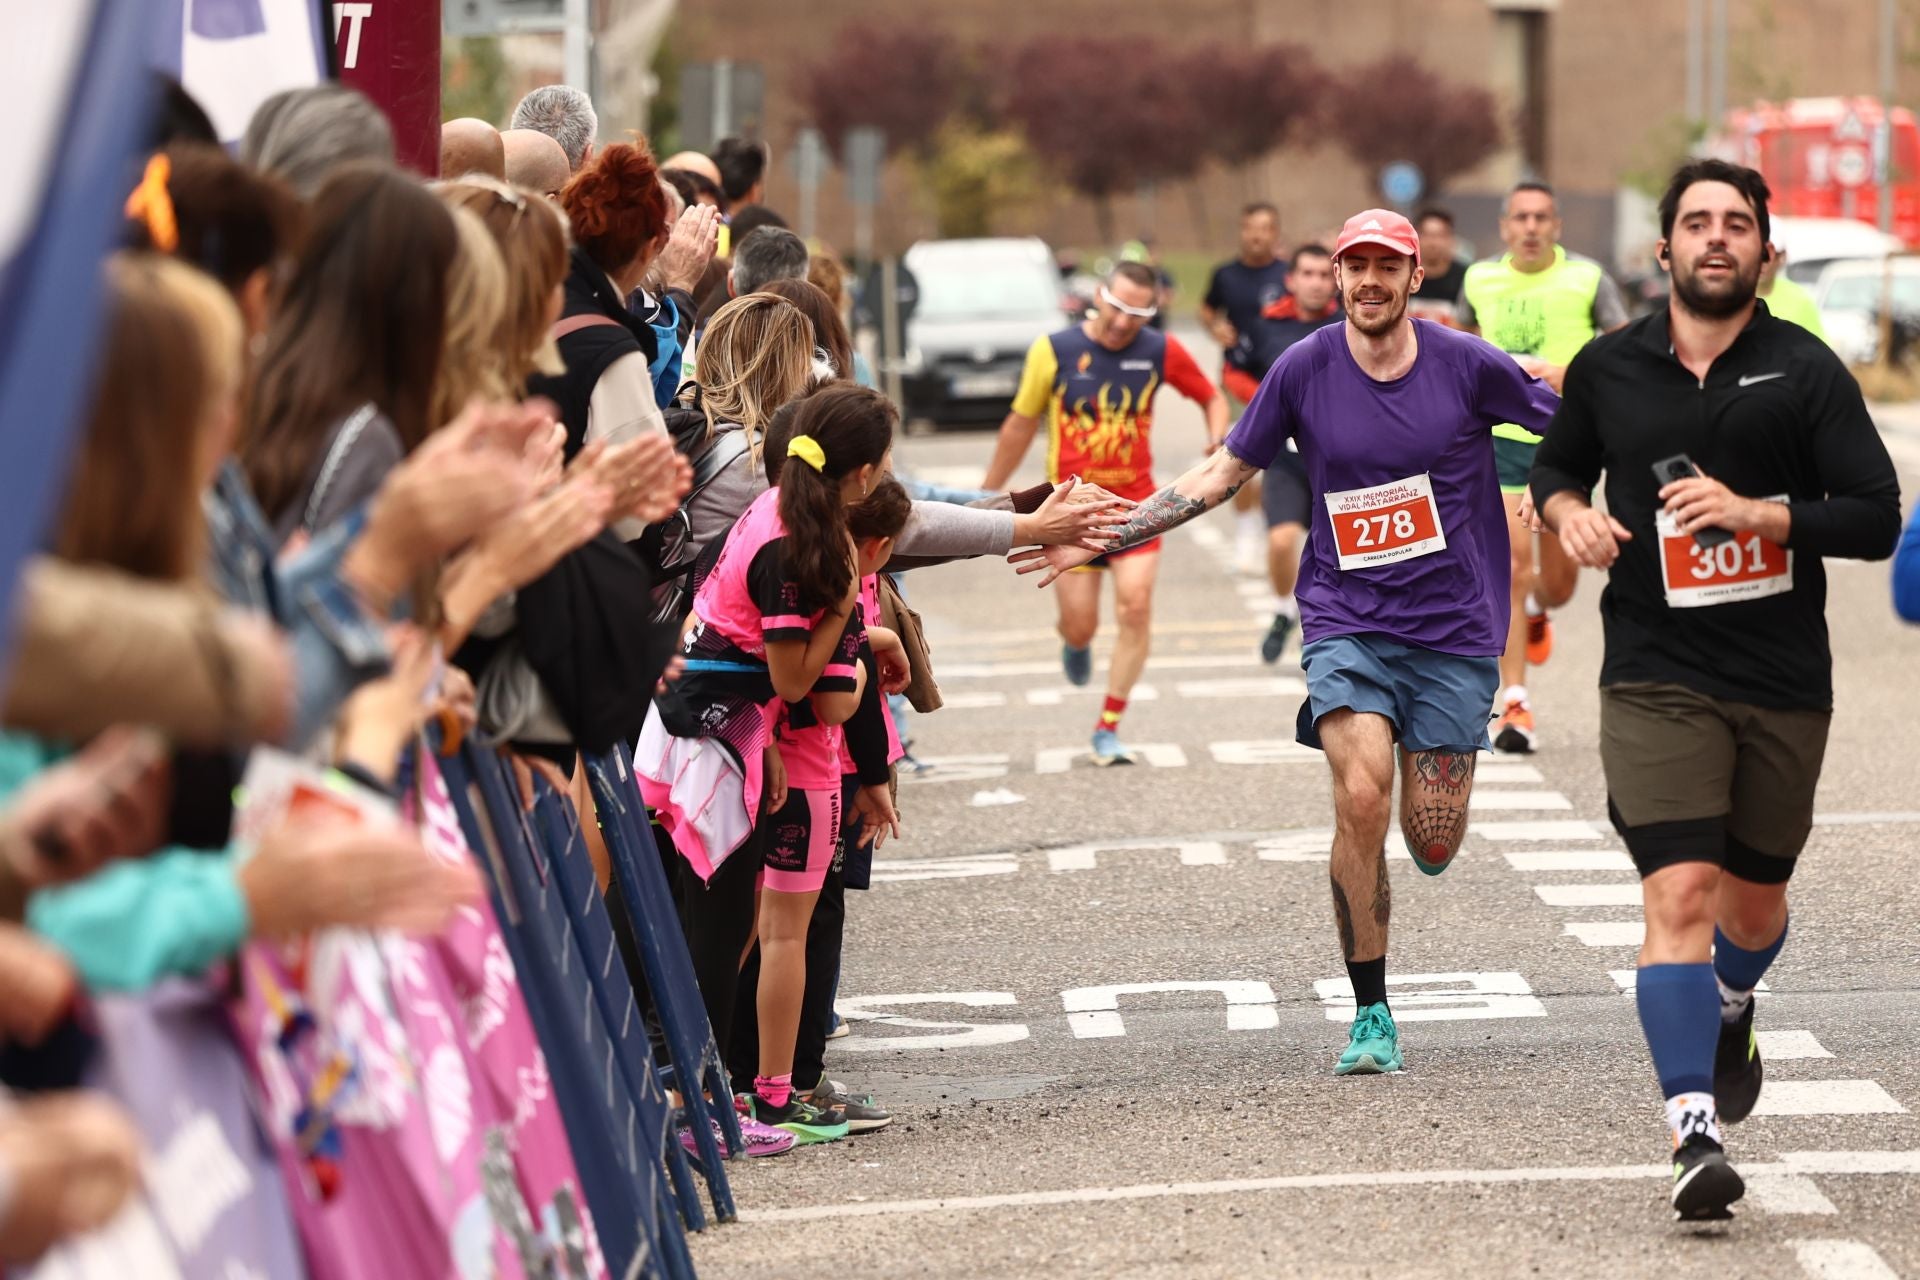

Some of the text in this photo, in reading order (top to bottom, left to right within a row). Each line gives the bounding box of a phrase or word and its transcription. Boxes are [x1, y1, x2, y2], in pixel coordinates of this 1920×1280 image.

[1338, 502, 1361, 512] VIDAL
[1363, 489, 1419, 509] MATARRANZ
[1343, 485, 1409, 503] XXIX MEMORIAL
[1352, 509, 1416, 548] 278
[1363, 547, 1413, 562] CARRERA POPULAR
[1689, 536, 1767, 580] 301
[830, 792, 839, 846] Valladolid
[824, 970, 1548, 1053] BUS
